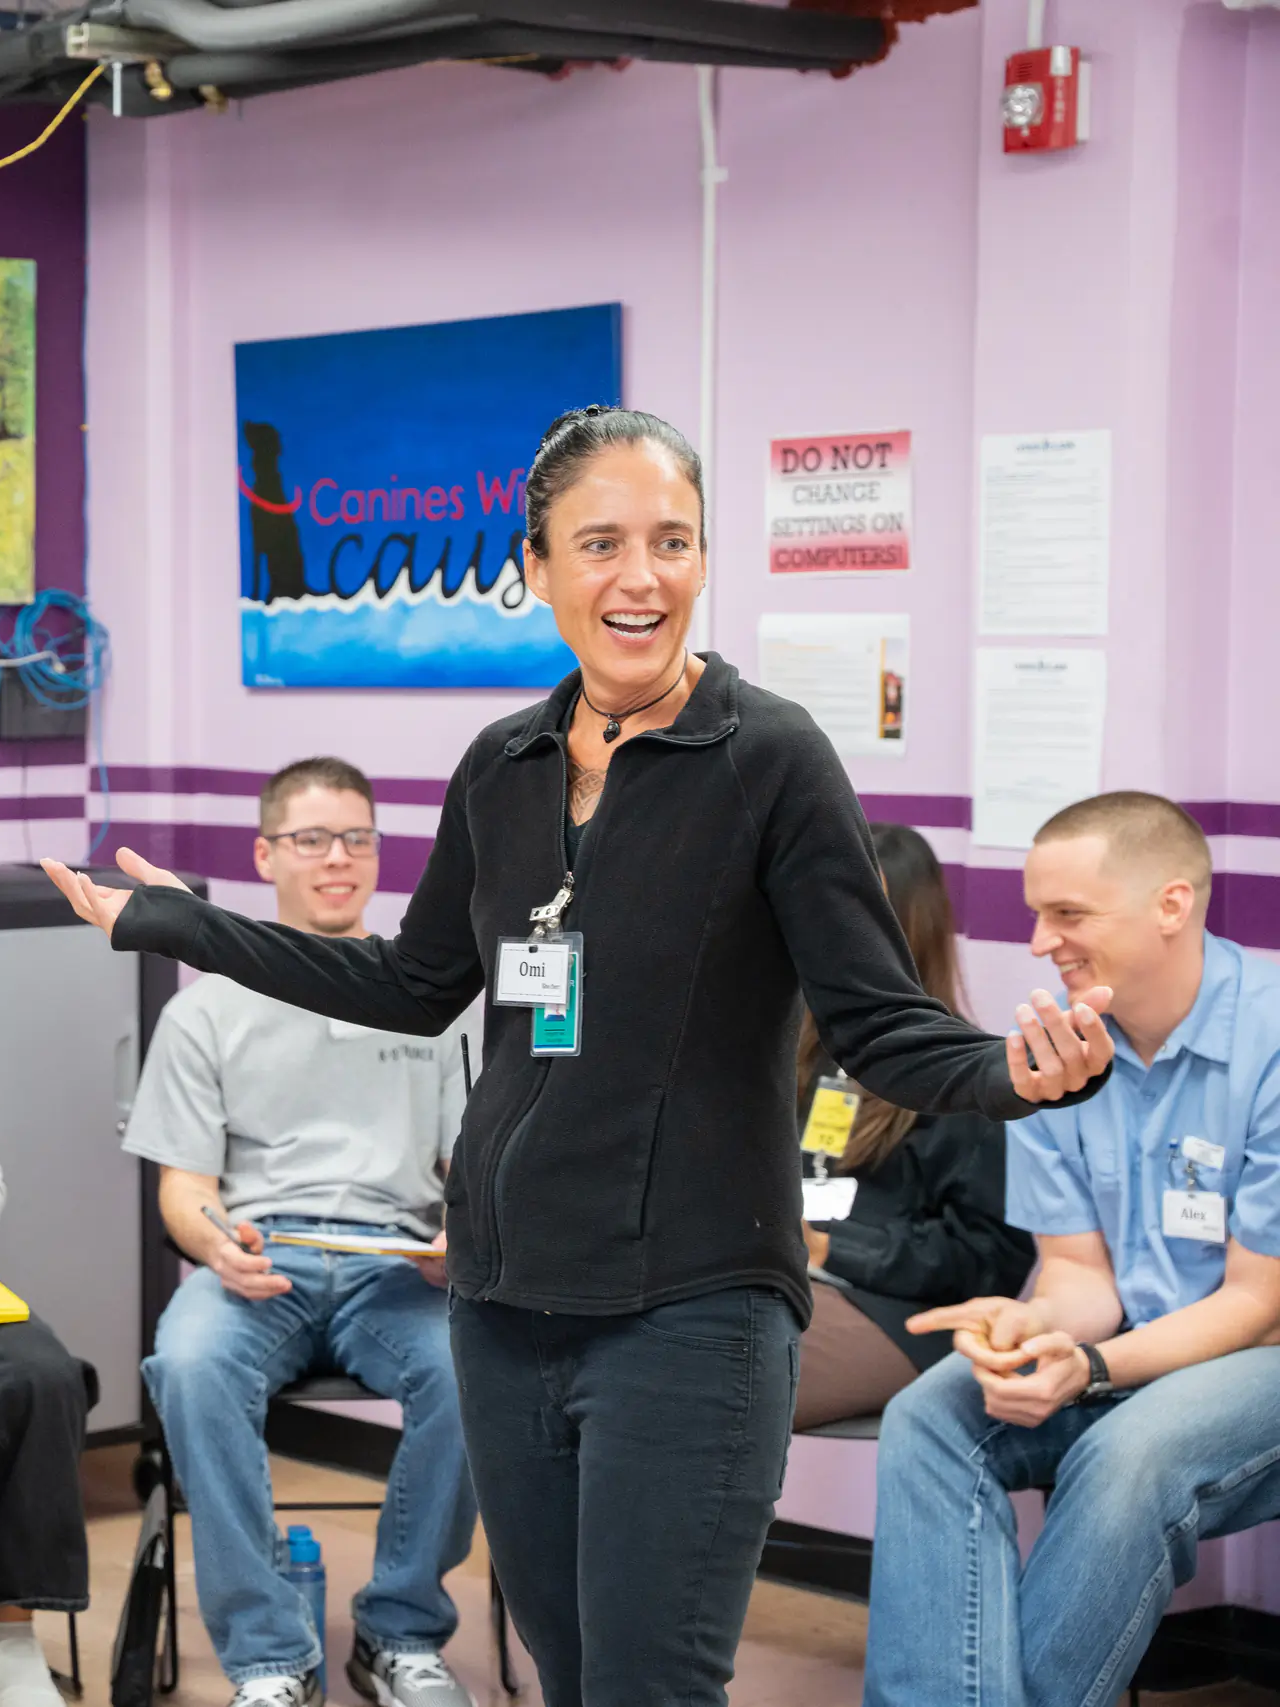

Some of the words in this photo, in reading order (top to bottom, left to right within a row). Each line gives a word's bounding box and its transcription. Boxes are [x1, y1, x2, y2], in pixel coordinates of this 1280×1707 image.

[781, 446, 822, 474] DO
[831, 442, 892, 471] NOT
[309, 474, 464, 526] Canines
[792, 481, 881, 506] CHANGE
[772, 513, 867, 537] SETTINGS
[871, 511, 904, 533] ON
[519, 961, 546, 977] Omi
[1181, 1208, 1207, 1220] Alex
